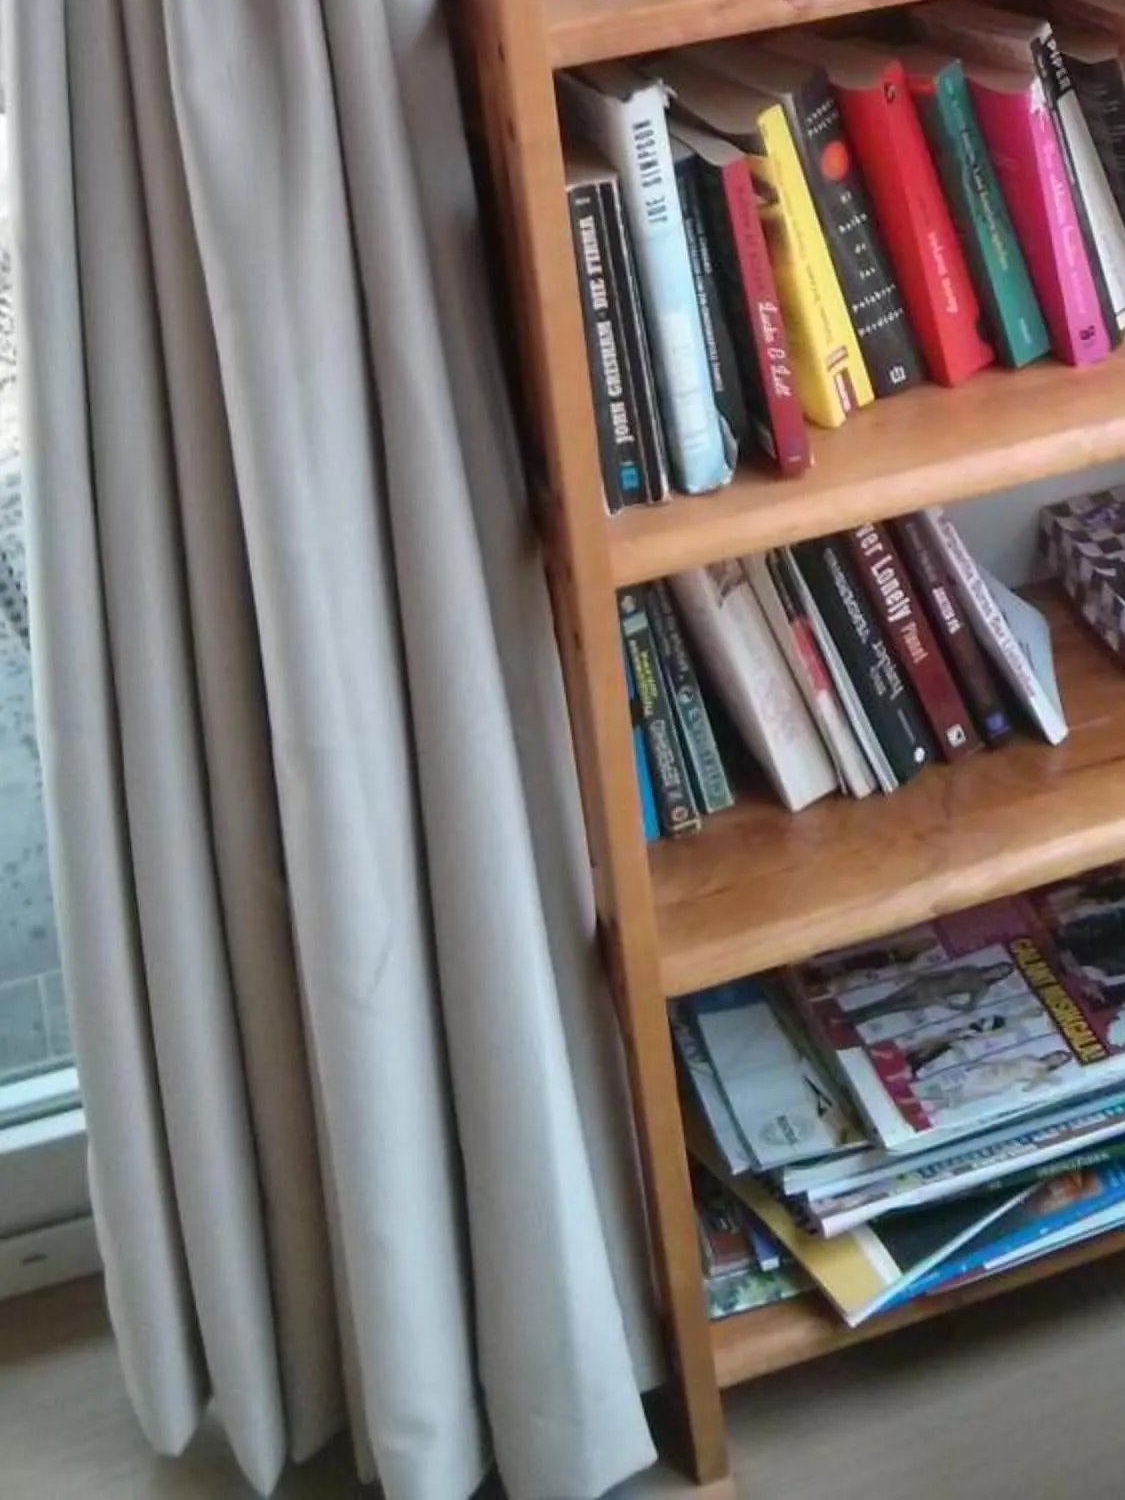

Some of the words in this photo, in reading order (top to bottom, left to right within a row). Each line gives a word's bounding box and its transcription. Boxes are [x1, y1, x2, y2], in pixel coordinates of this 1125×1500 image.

[1042, 36, 1074, 92] PIPER
[630, 118, 663, 187] SIMPSON
[644, 195, 669, 225] JOE
[576, 215, 603, 272] FIRMA
[587, 276, 609, 310] DIE
[595, 320, 625, 396] GRISHAM
[608, 399, 635, 444] JOHN
[864, 554, 915, 623] Lonely
[897, 620, 930, 665] Planet
